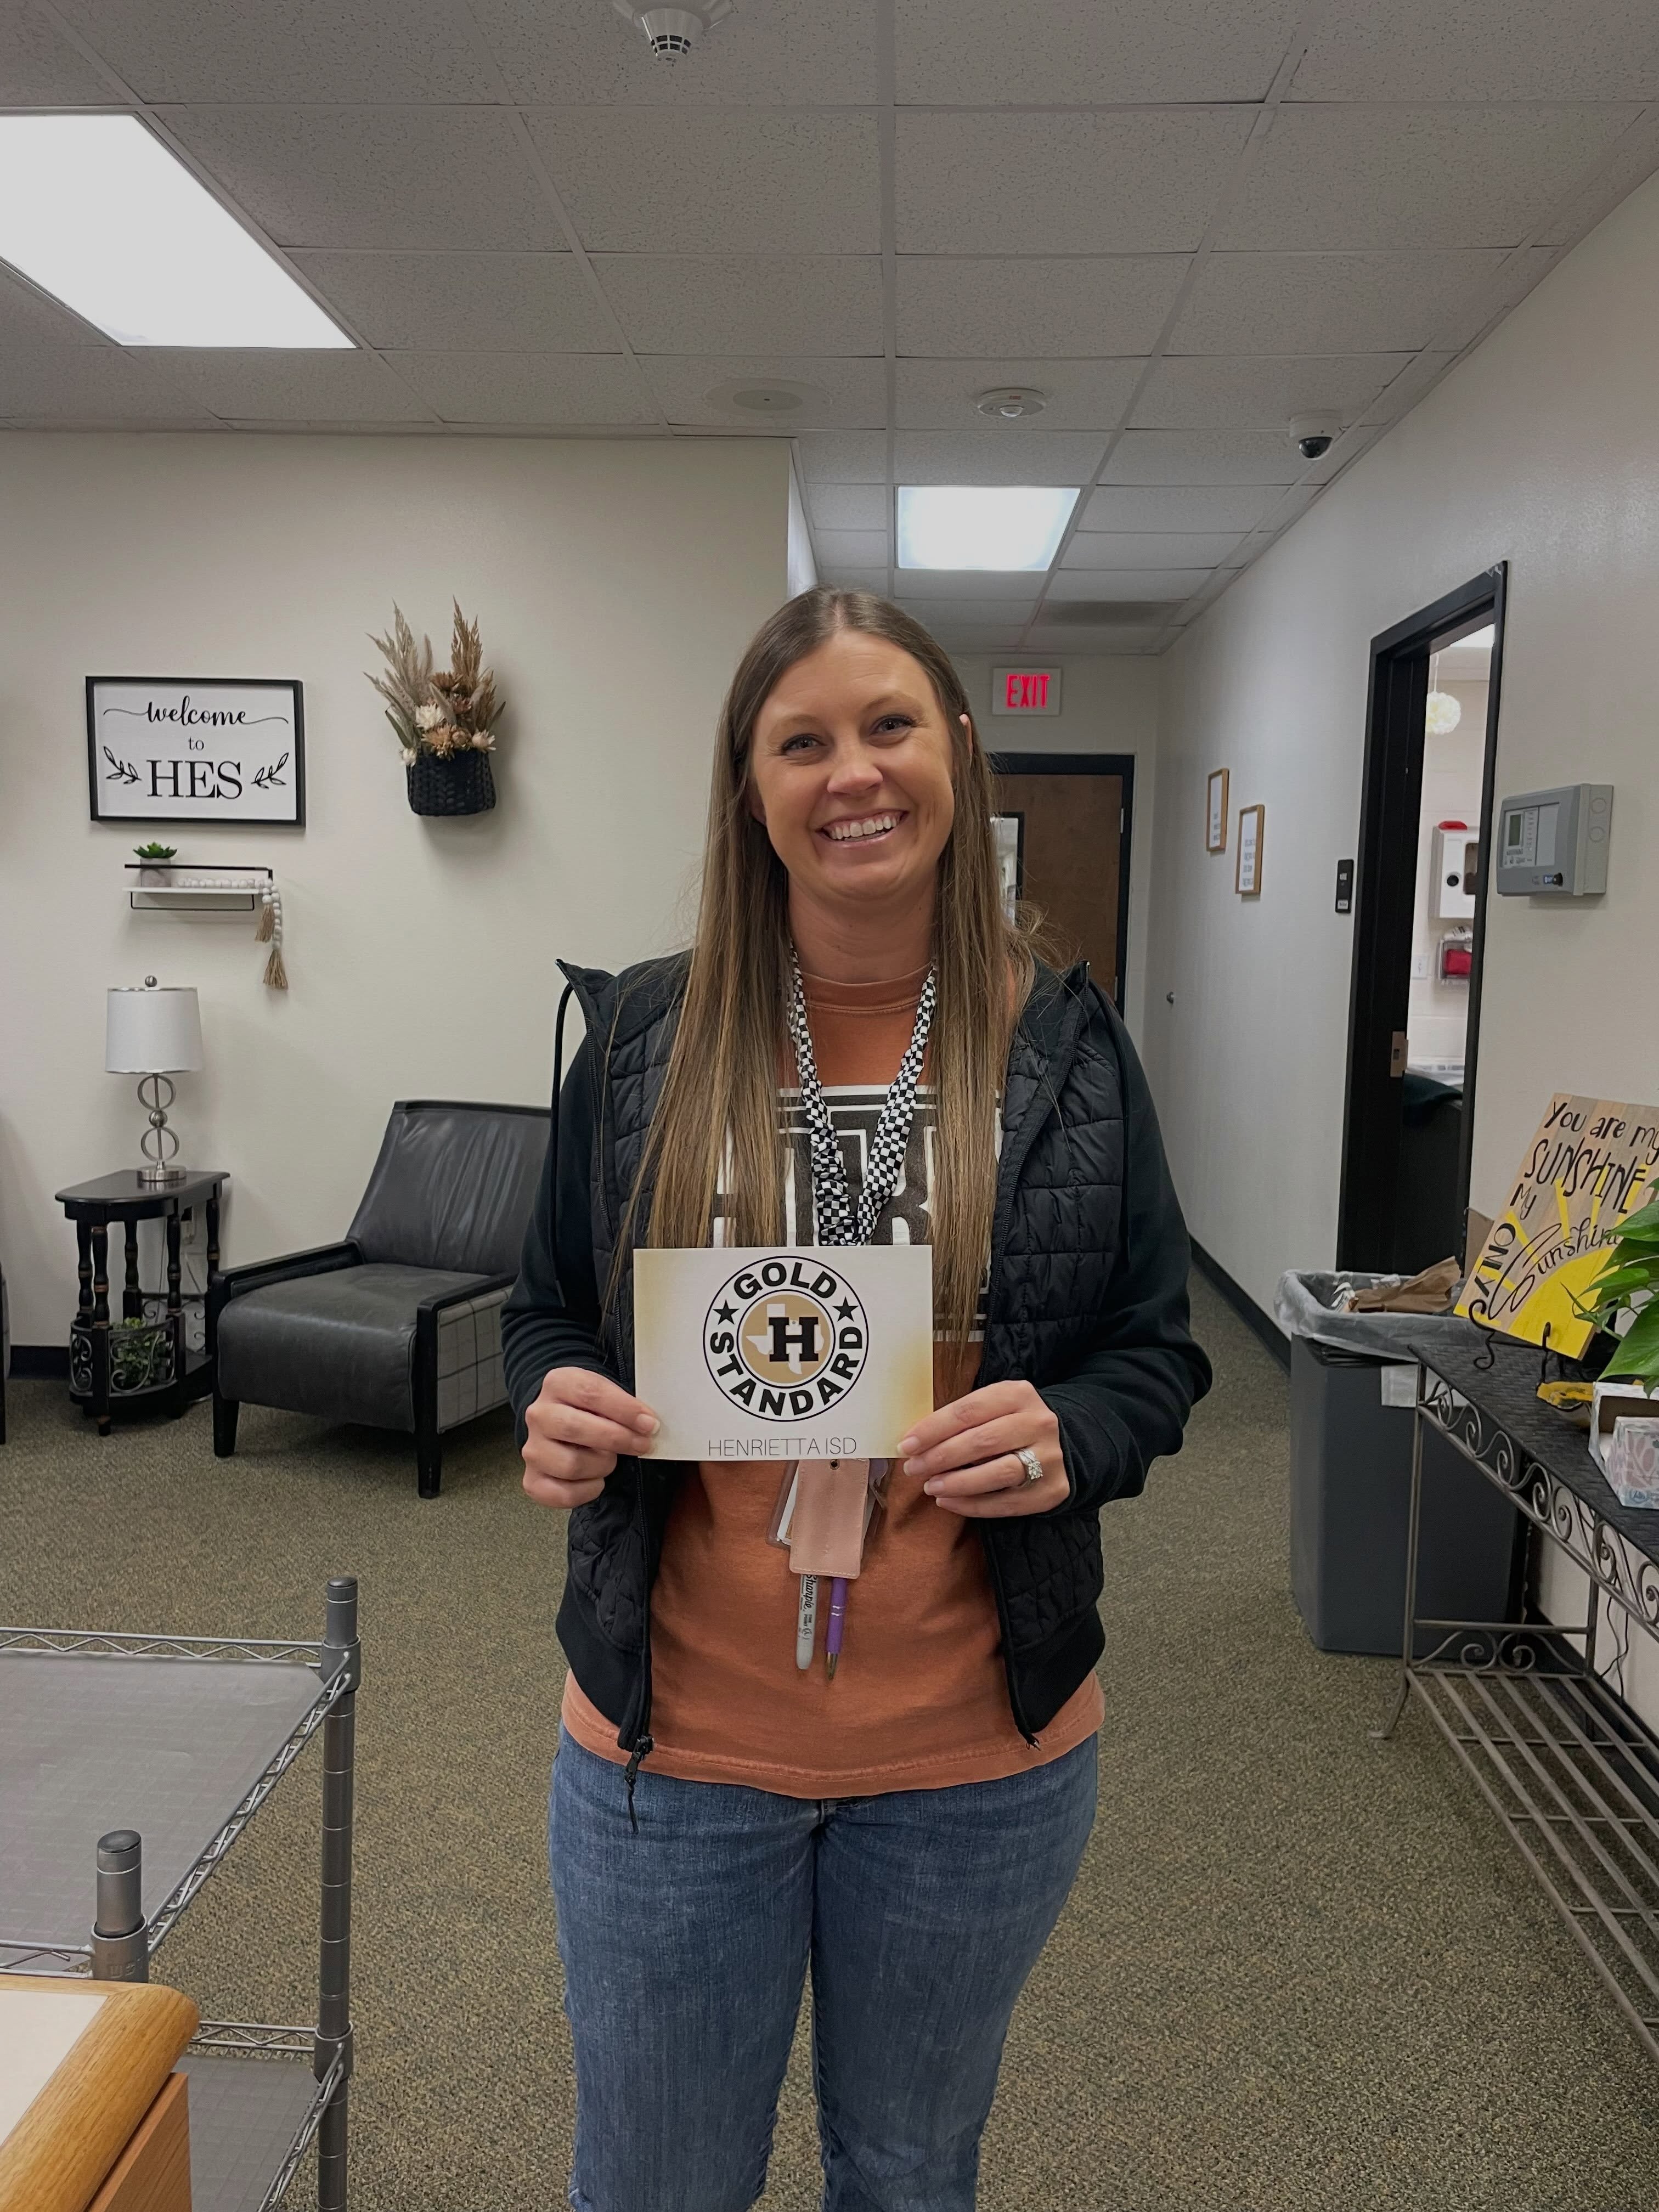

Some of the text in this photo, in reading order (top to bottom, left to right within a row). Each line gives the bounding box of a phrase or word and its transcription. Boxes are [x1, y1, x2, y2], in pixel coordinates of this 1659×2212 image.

[1006, 674, 1051, 708] EXIT
[103, 695, 289, 726] welcome
[188, 736, 205, 751] to
[146, 759, 242, 799] HES
[1544, 1101, 1587, 1132] You
[1590, 1117, 1627, 1139] are
[1524, 1135, 1646, 1214] SUNSHINE
[1474, 1223, 1516, 1297] ONLY
[734, 1262, 837, 1300] GOLD
[769, 1317, 819, 1362] H
[710, 1327, 862, 1417] STANDARD
[708, 1437, 857, 1457] HENRIETTA ISD
